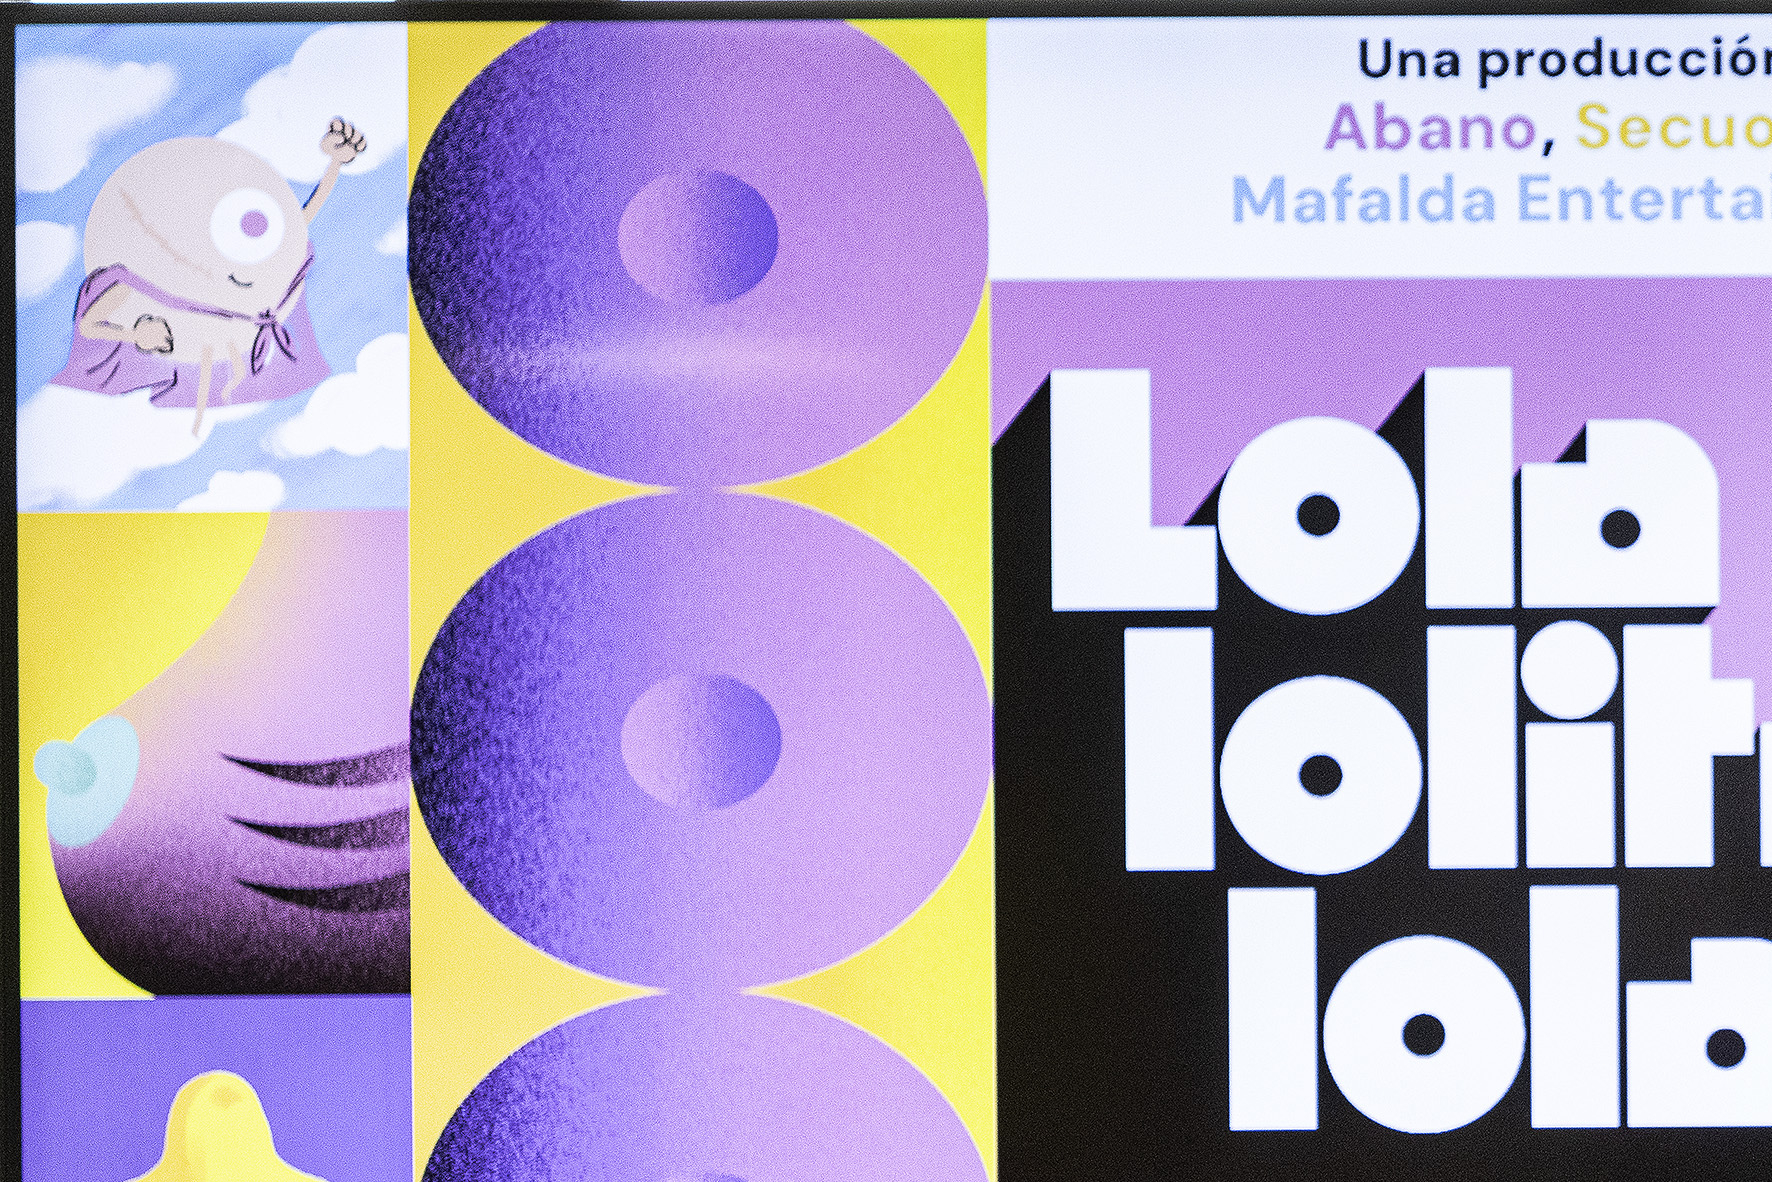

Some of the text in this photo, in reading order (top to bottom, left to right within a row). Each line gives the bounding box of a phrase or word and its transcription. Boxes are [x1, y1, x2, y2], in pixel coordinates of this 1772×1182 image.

[1358, 37, 1461, 80] Una
[1324, 101, 1556, 158] Abano,
[1233, 173, 1496, 224] Mafalda
[1050, 366, 1721, 615] Lola
